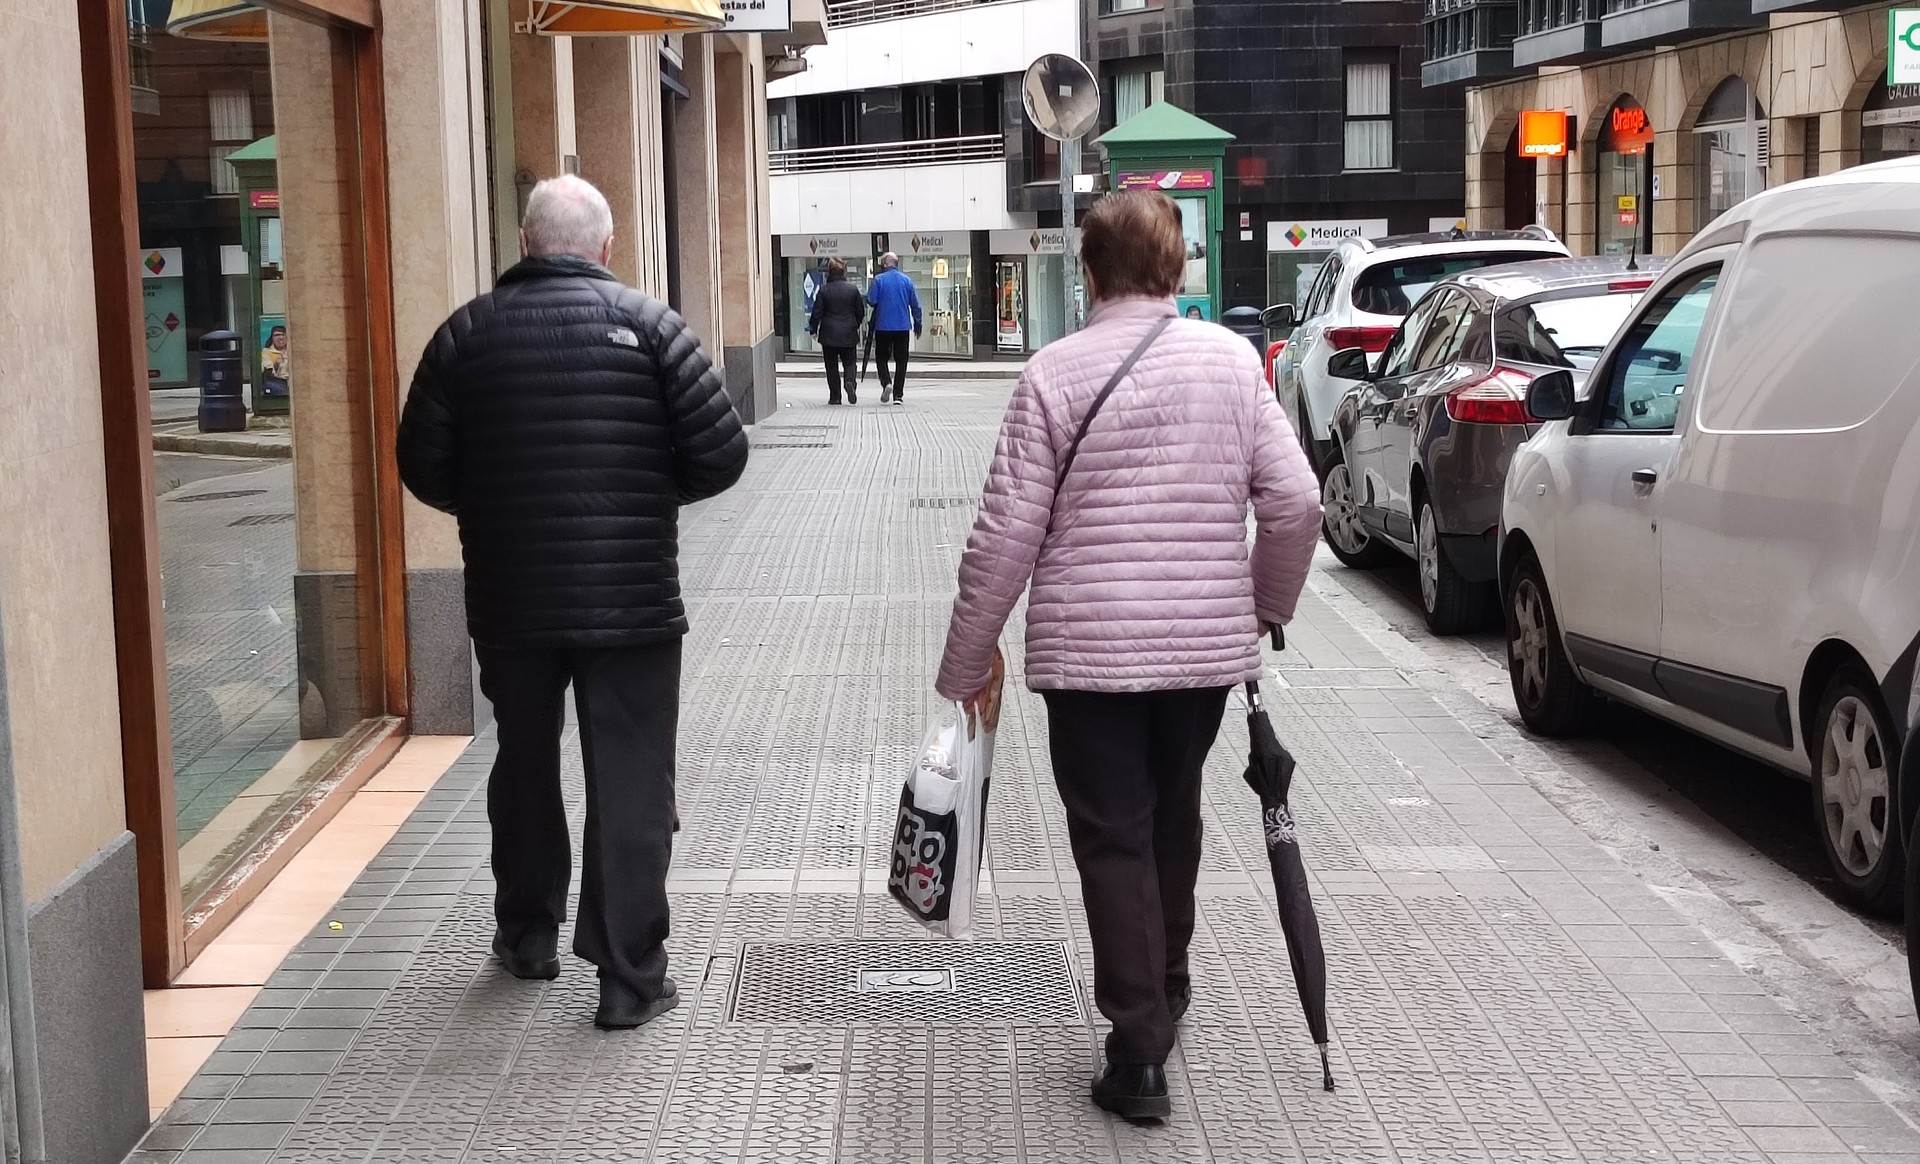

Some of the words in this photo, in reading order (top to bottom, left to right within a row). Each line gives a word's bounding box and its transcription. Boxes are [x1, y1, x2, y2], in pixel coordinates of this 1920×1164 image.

[720, 0, 747, 10] estas
[750, 0, 765, 10] del
[1904, 62, 1920, 71] FAR
[1888, 84, 1920, 100] GAZIE
[1613, 107, 1644, 134] Orange
[1311, 226, 1361, 238] Medical
[818, 238, 838, 248] Medical
[921, 236, 944, 246] Medical
[1041, 234, 1064, 244] Medica
